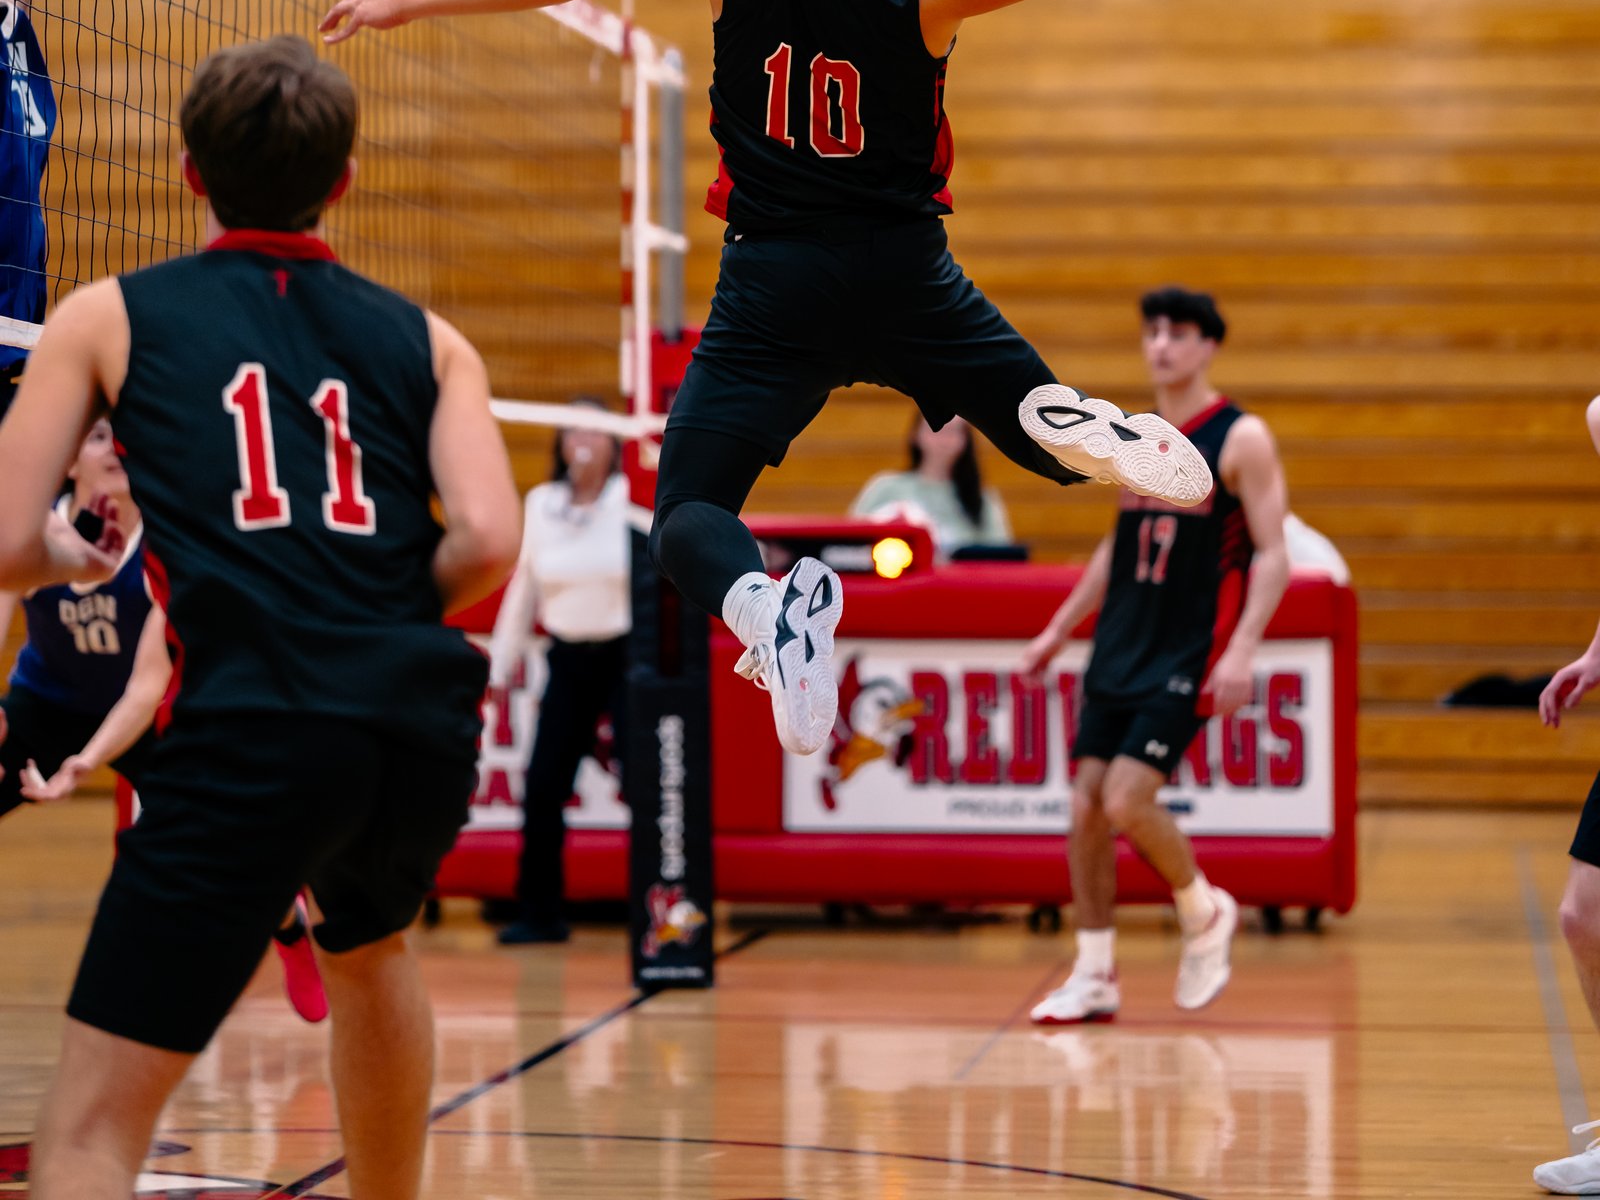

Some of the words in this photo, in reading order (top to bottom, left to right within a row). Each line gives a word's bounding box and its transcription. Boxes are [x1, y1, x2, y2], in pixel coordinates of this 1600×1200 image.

[765, 42, 864, 158] 10
[221, 361, 377, 537] 11
[1134, 514, 1178, 585] 17
[72, 618, 121, 655] 10
